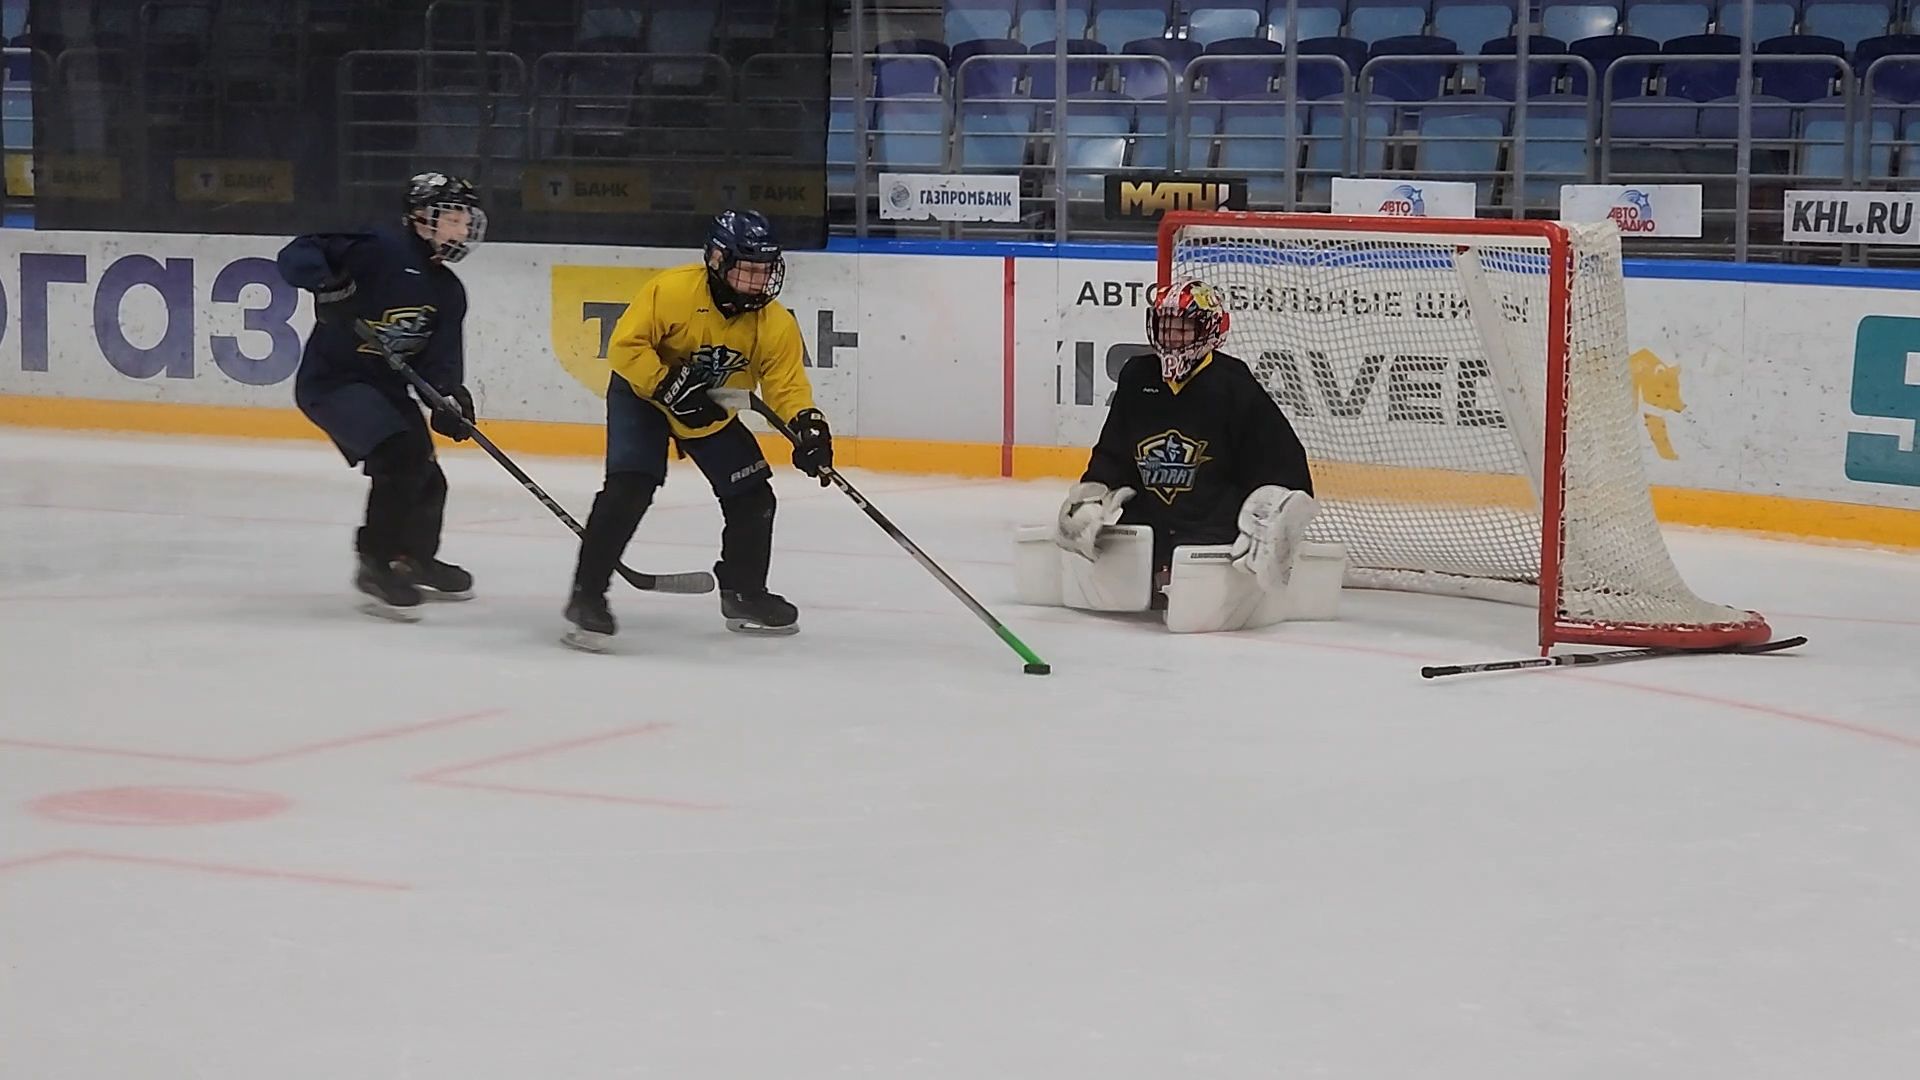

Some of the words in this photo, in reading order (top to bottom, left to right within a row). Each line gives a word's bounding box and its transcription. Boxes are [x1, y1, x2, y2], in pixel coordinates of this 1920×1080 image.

[573, 183, 629, 198] БАНК
[919, 190, 1012, 206] ГАЗПРОМБАНК
[1378, 200, 1411, 214] АВТО
[1606, 206, 1638, 220] АВТО
[1792, 200, 1913, 234] KHL.RU
[0, 252, 301, 386] газ
